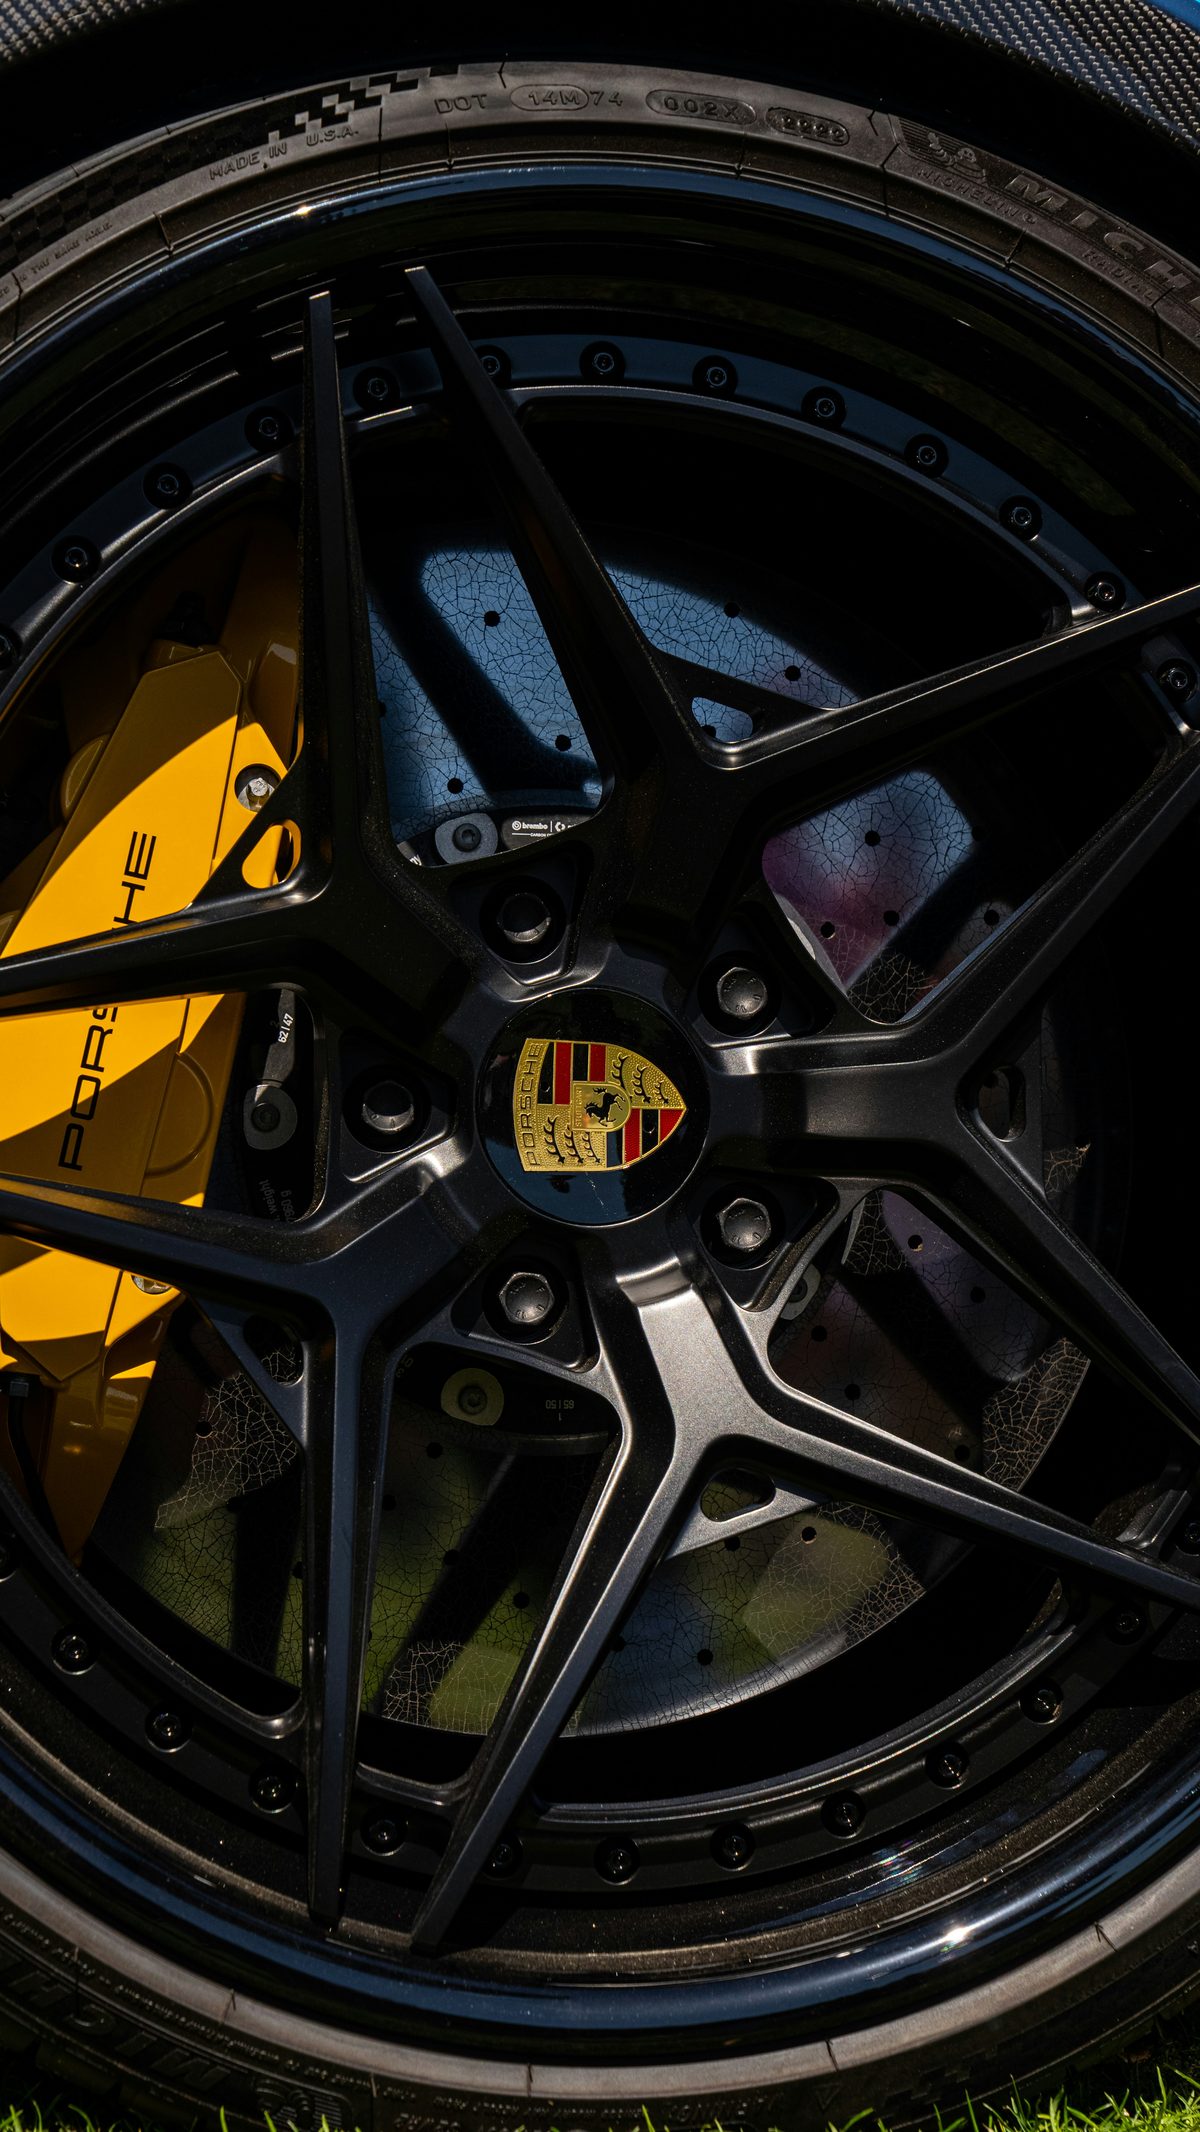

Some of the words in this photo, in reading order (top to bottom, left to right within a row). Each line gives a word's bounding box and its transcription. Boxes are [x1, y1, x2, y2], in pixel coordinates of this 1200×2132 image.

[434, 94, 487, 114] DOT
[528, 89, 581, 106] 14M
[589, 90, 624, 107] 74
[664, 96, 740, 120] 002X
[781, 114, 845, 143] 2222
[209, 151, 260, 181] MADE
[268, 142, 288, 159] IN
[305, 126, 360, 147] U.S.A.
[1003, 173, 1200, 312] MICH
[1081, 250, 1155, 302] RADIAL
[521, 822, 549, 830] brembo
[519, 1043, 544, 1166] PORSCHE
[258, 1178, 277, 1215] weight
